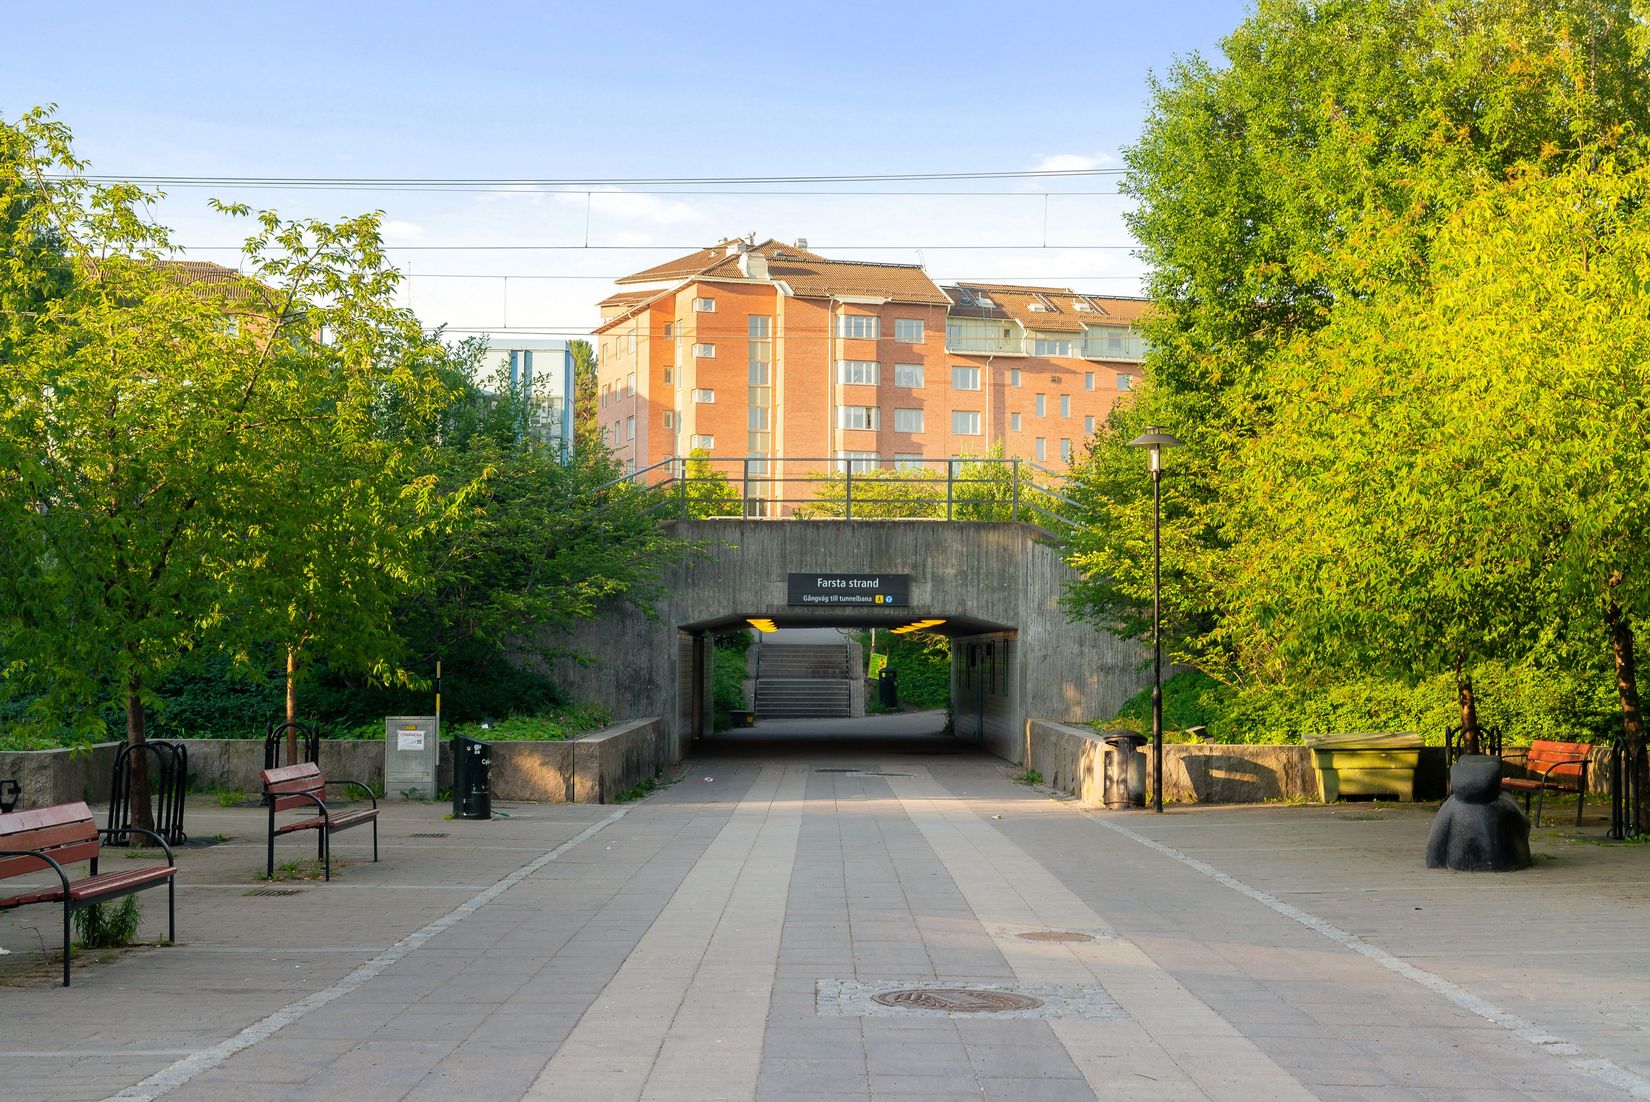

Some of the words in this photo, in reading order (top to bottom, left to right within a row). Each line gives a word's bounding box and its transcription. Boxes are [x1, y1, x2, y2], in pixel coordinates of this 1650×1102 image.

[817, 577, 846, 588] Farsta
[848, 577, 879, 588] strand
[803, 595, 829, 603] Gångväg
